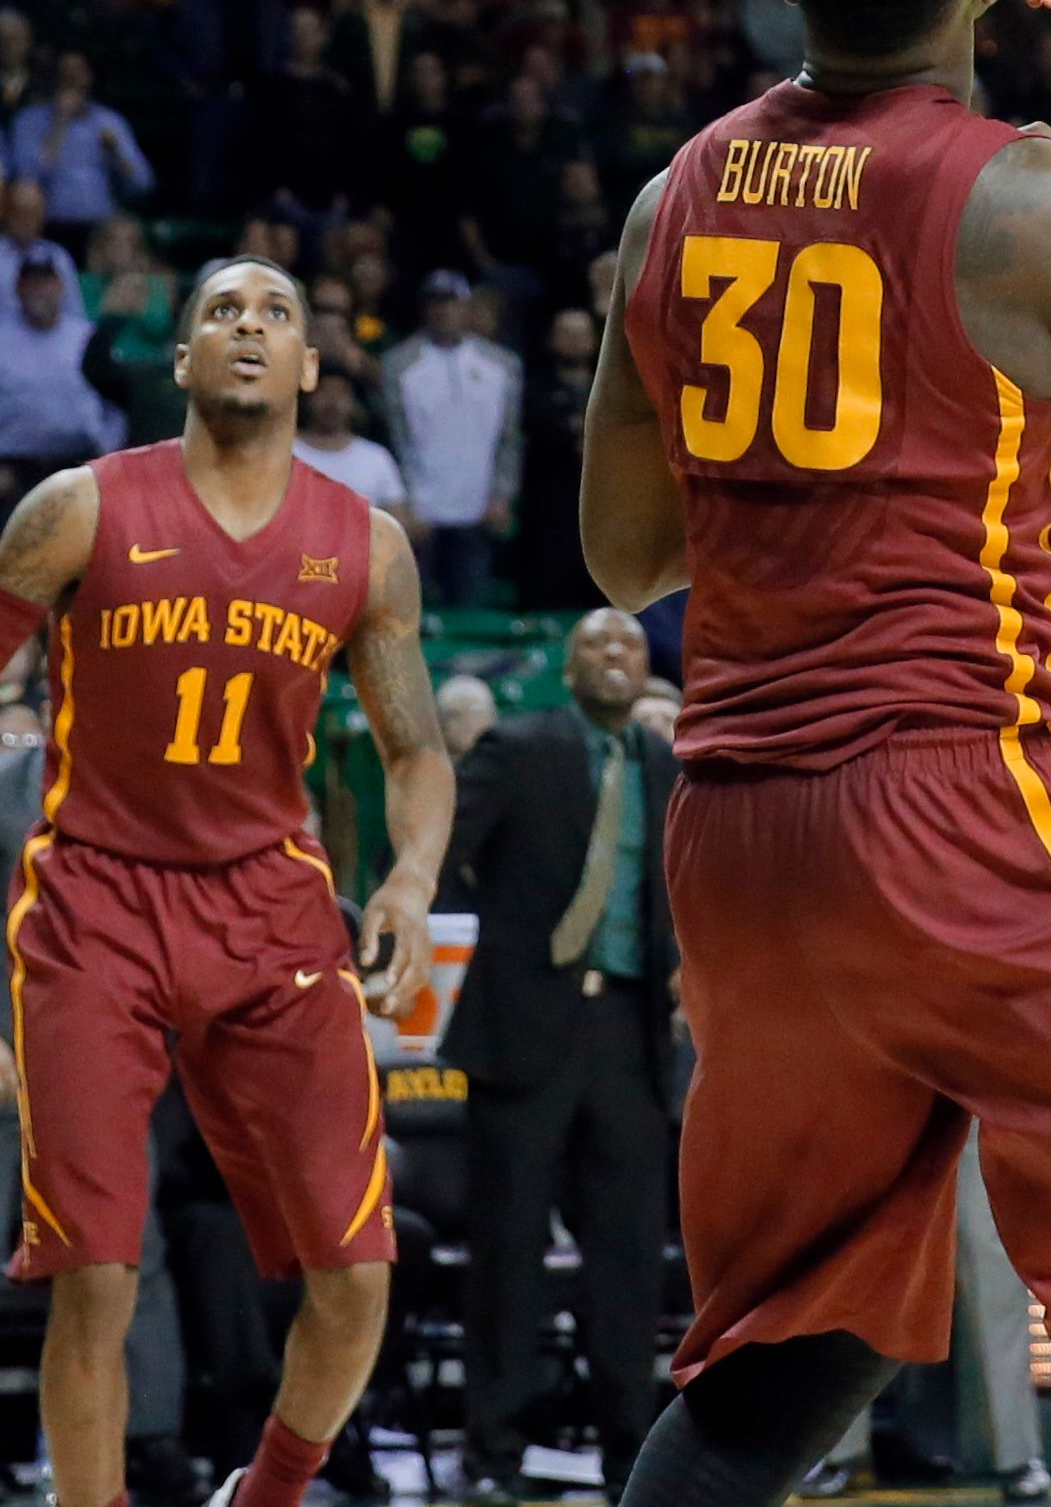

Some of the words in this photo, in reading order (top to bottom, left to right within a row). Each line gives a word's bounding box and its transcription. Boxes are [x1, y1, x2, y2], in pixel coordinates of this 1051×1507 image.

[717, 139, 872, 211] BURTON
[681, 235, 883, 470] 30
[100, 597, 209, 650] IOWA
[164, 667, 254, 765] 11
